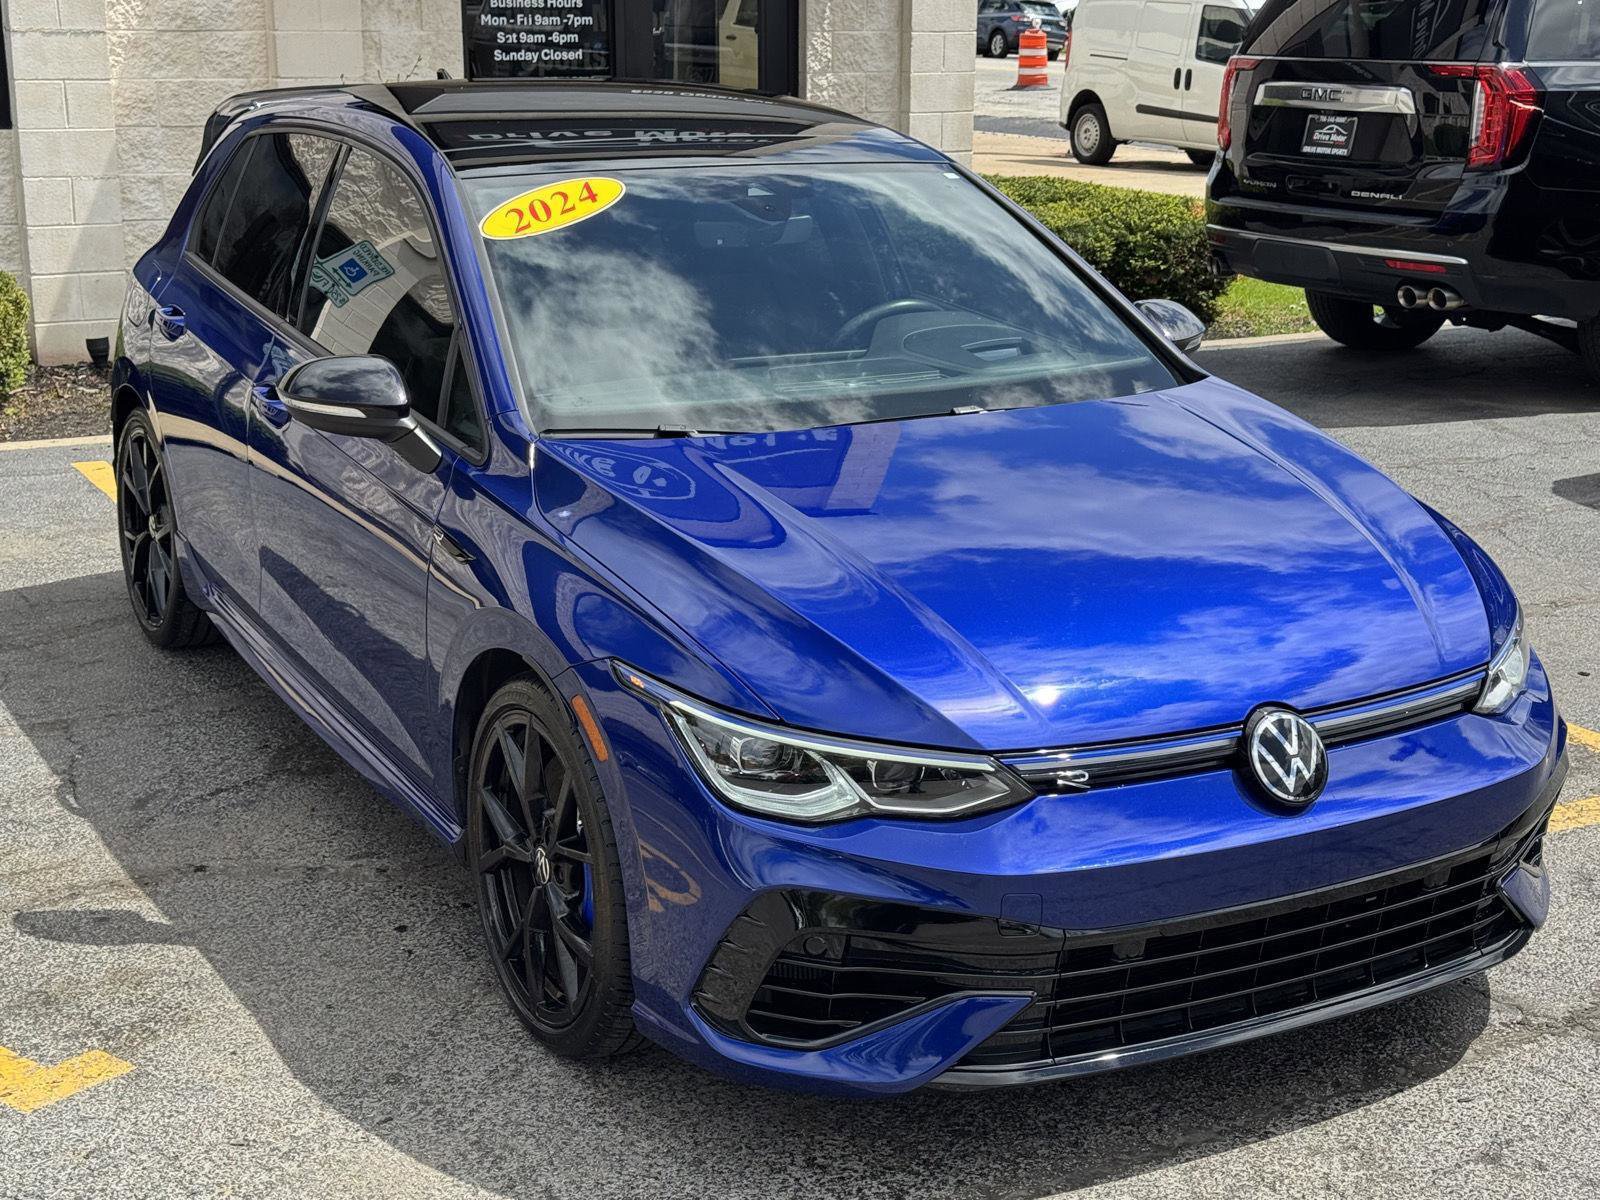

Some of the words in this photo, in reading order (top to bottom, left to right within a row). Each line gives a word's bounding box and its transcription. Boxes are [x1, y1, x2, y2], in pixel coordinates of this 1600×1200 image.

[490, 0, 545, 8] Business
[547, 0, 583, 8] Hours
[481, 14, 507, 26] Mon
[517, 14, 532, 26] Fri
[535, 14, 561, 26] 9am
[497, 32, 517, 43] Sat
[520, 32, 545, 43] 9am
[494, 49, 538, 63] Sunday
[541, 49, 583, 61] Closed
[1301, 88, 1344, 101] GMC
[1313, 132, 1330, 140] Drive
[1243, 179, 1278, 188] YUKON
[1351, 190, 1403, 200] DENALI
[505, 181, 598, 233] 2024
